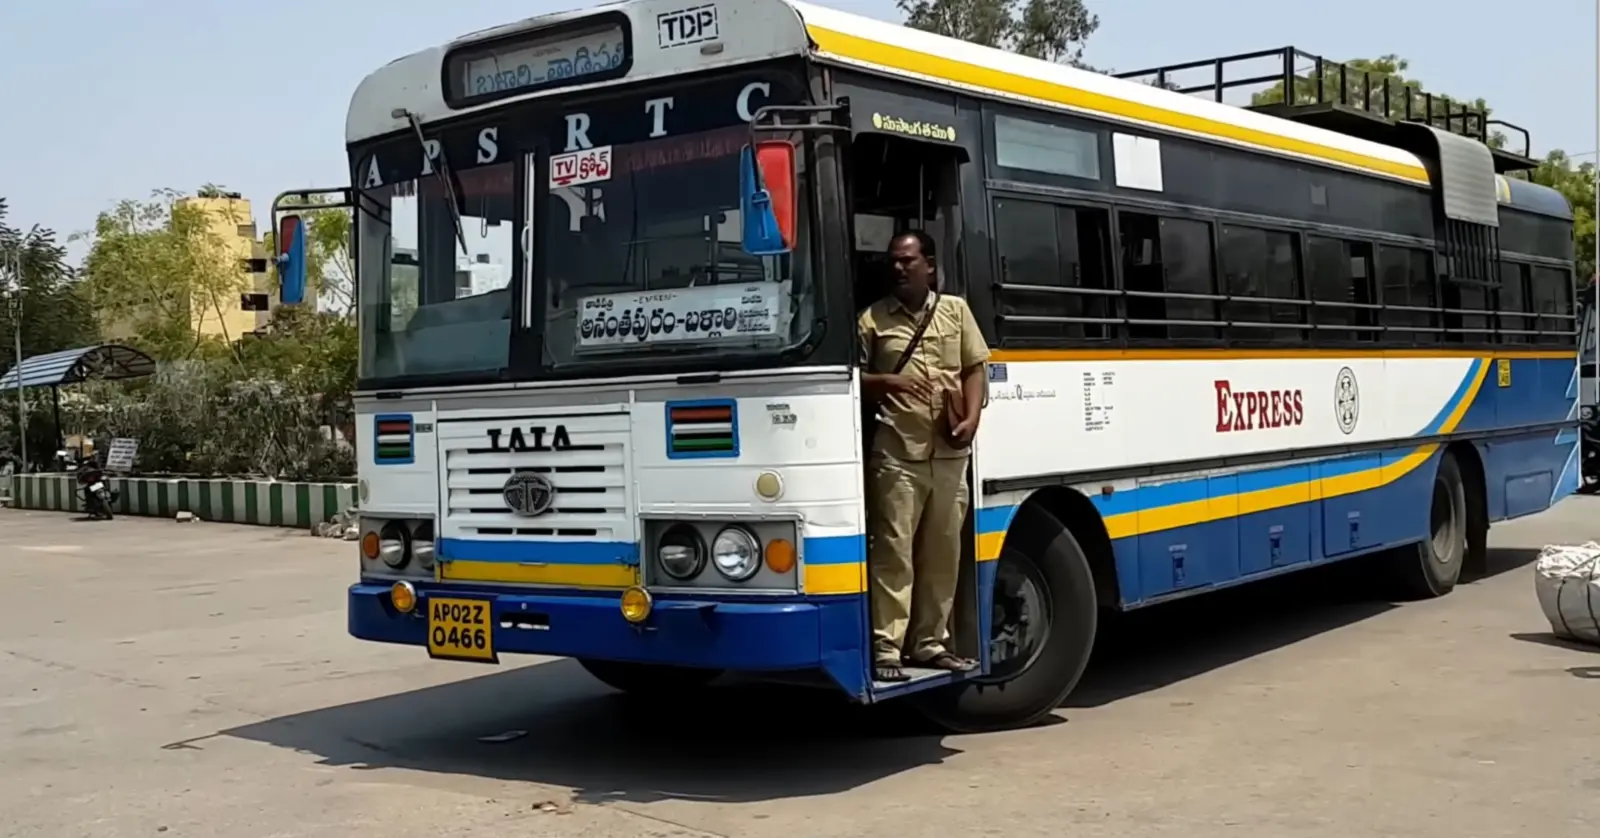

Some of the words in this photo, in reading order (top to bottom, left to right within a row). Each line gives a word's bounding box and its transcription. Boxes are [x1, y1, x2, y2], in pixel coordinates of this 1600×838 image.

[661, 11, 714, 41] TDP
[556, 160, 573, 175] TV
[487, 424, 571, 450] TATA
[433, 603, 484, 624] AP02Z
[432, 625, 486, 650] 0466
